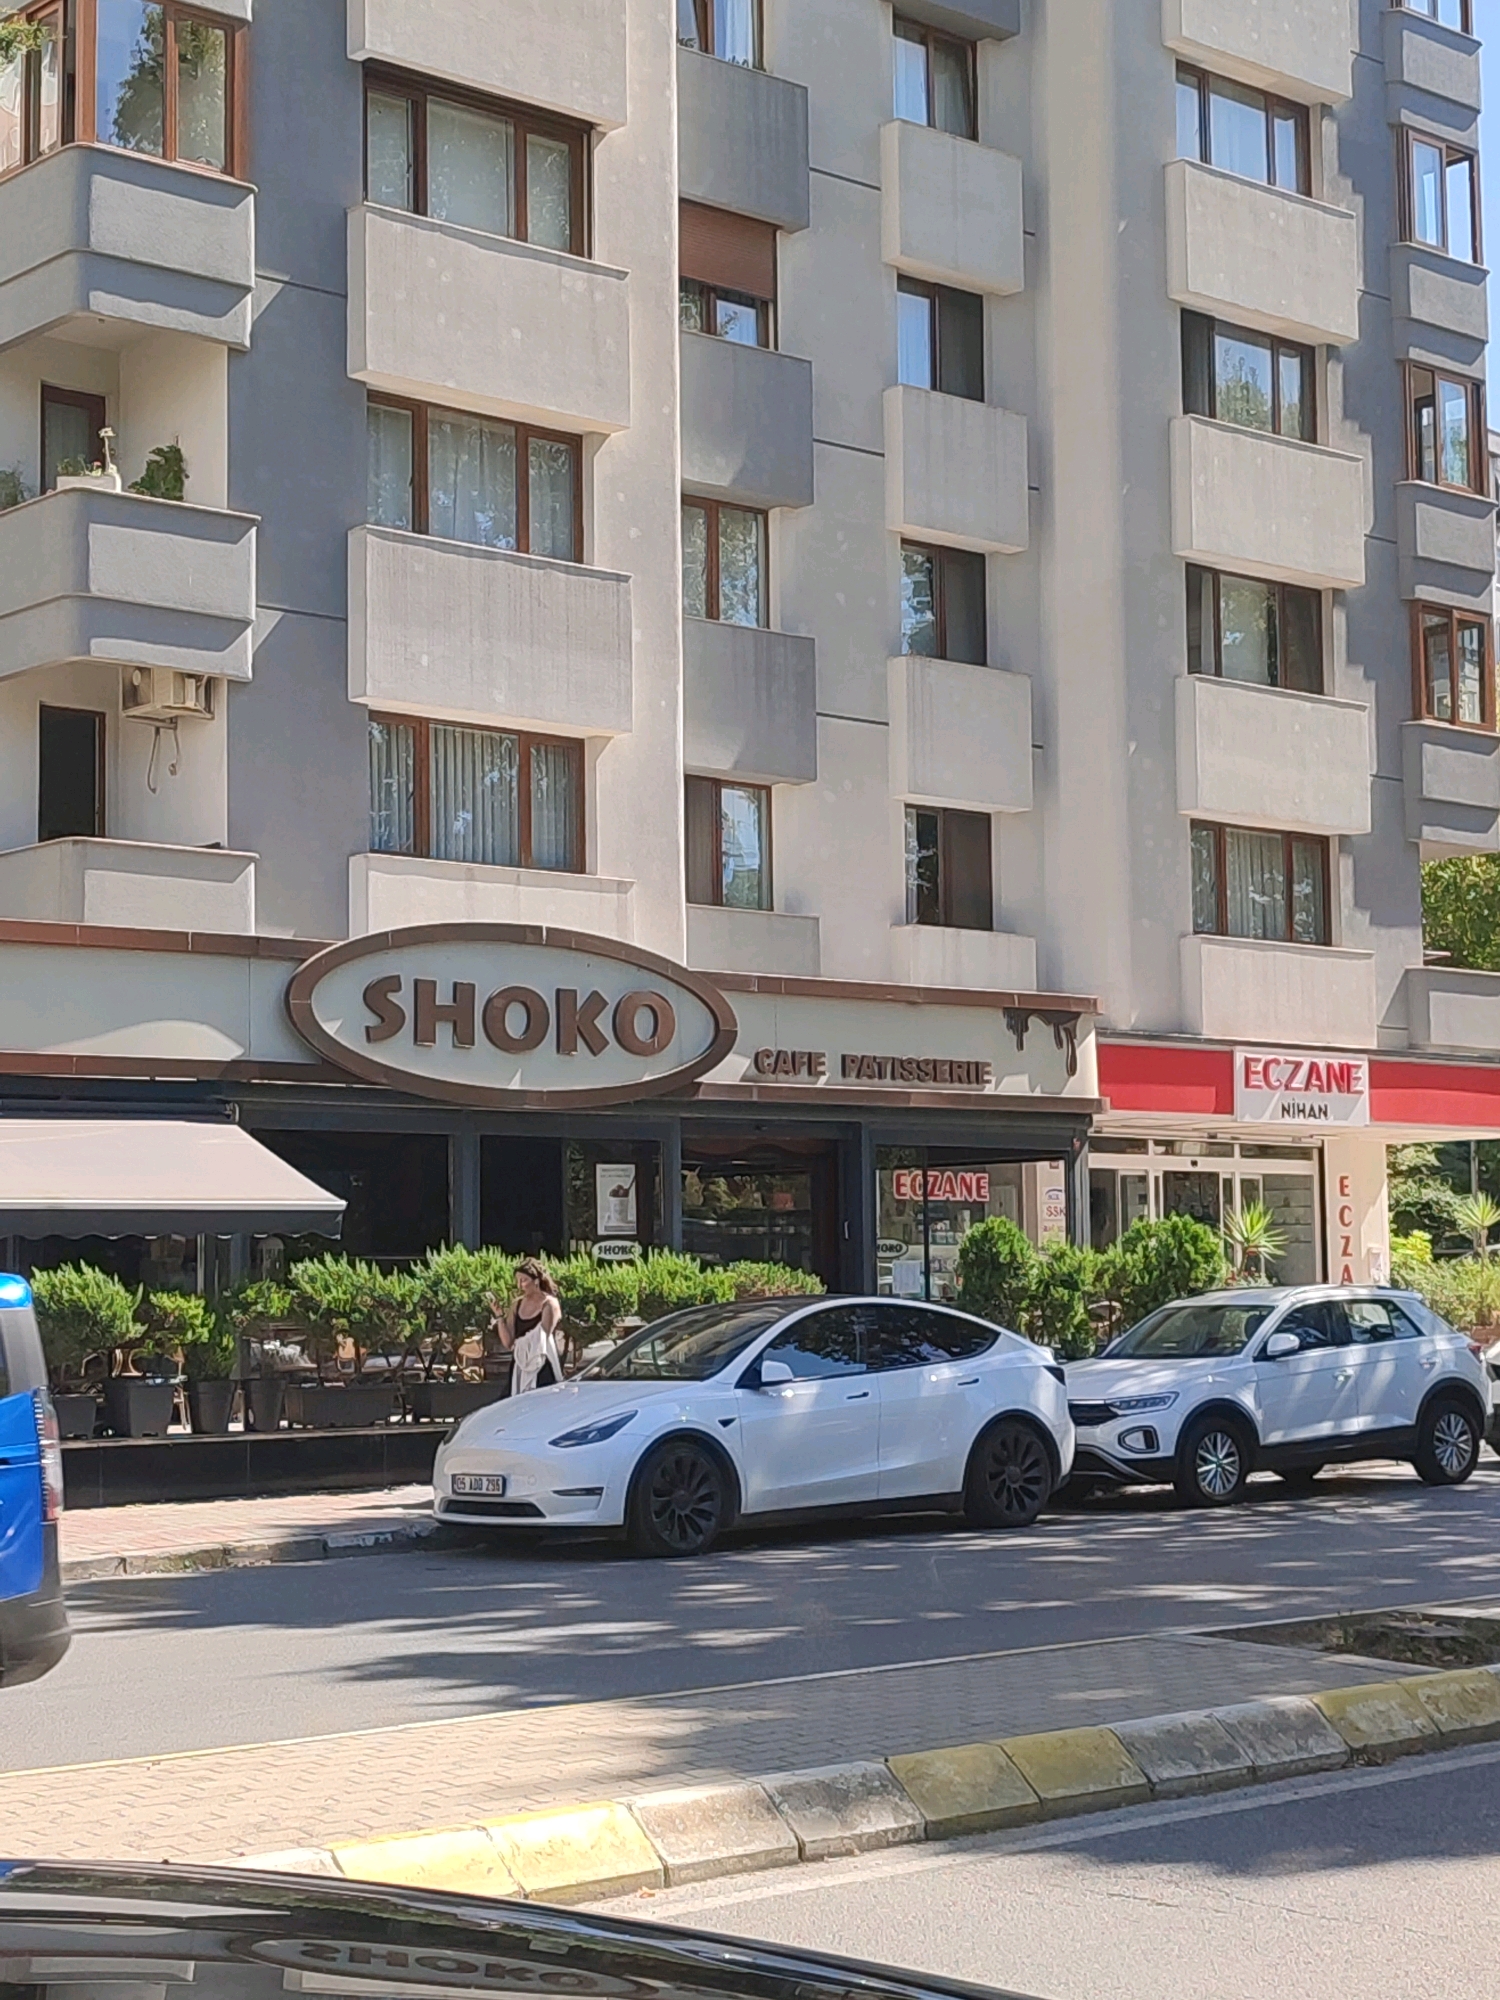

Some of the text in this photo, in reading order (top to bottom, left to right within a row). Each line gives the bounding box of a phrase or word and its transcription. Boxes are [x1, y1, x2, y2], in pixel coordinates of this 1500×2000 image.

[362, 974, 676, 1057] SHOKO
[754, 1048, 992, 1084] CAFE PATISSERIE
[1244, 1055, 1365, 1095] ECZANE
[1281, 1097, 1328, 1119] NİHAN
[893, 1169, 990, 1202] ECZANE
